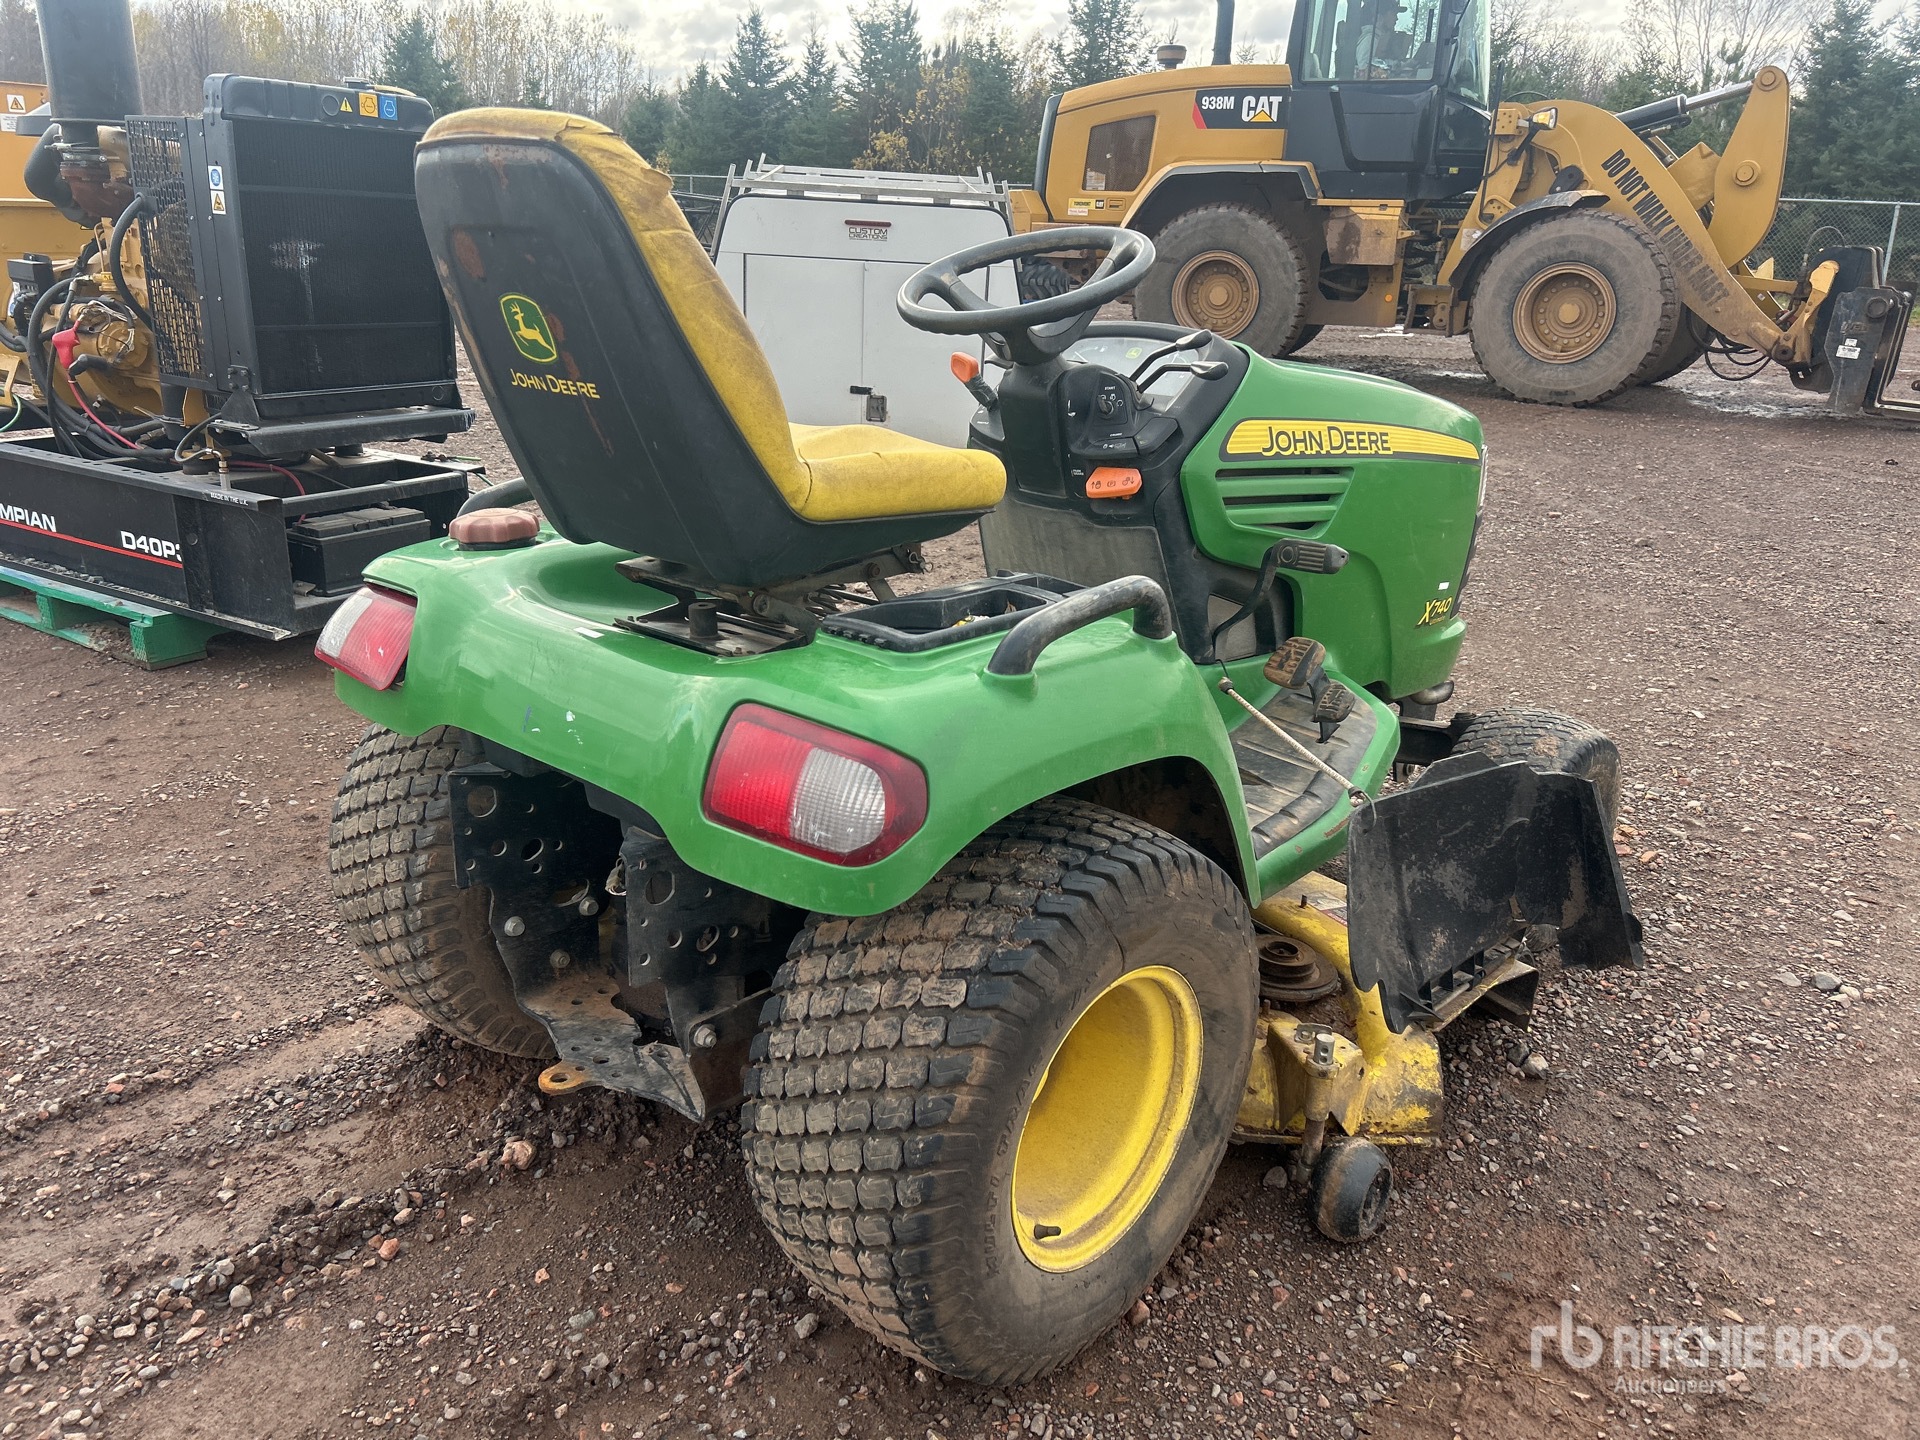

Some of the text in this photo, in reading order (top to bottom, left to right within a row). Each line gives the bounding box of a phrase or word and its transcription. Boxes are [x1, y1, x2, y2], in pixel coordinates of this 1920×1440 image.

[1201, 95, 1283, 122] 938M CAT
[1601, 149, 1631, 178] DO
[1614, 166, 1650, 202] NOT
[1632, 190, 1676, 236] WALK
[848, 226, 888, 235] CUSTOM
[510, 368, 600, 399] JOHN DEERE
[1262, 426, 1391, 453] JOHN DEERE
[0, 503, 57, 532] MPIAN
[1417, 597, 1452, 626] X740
